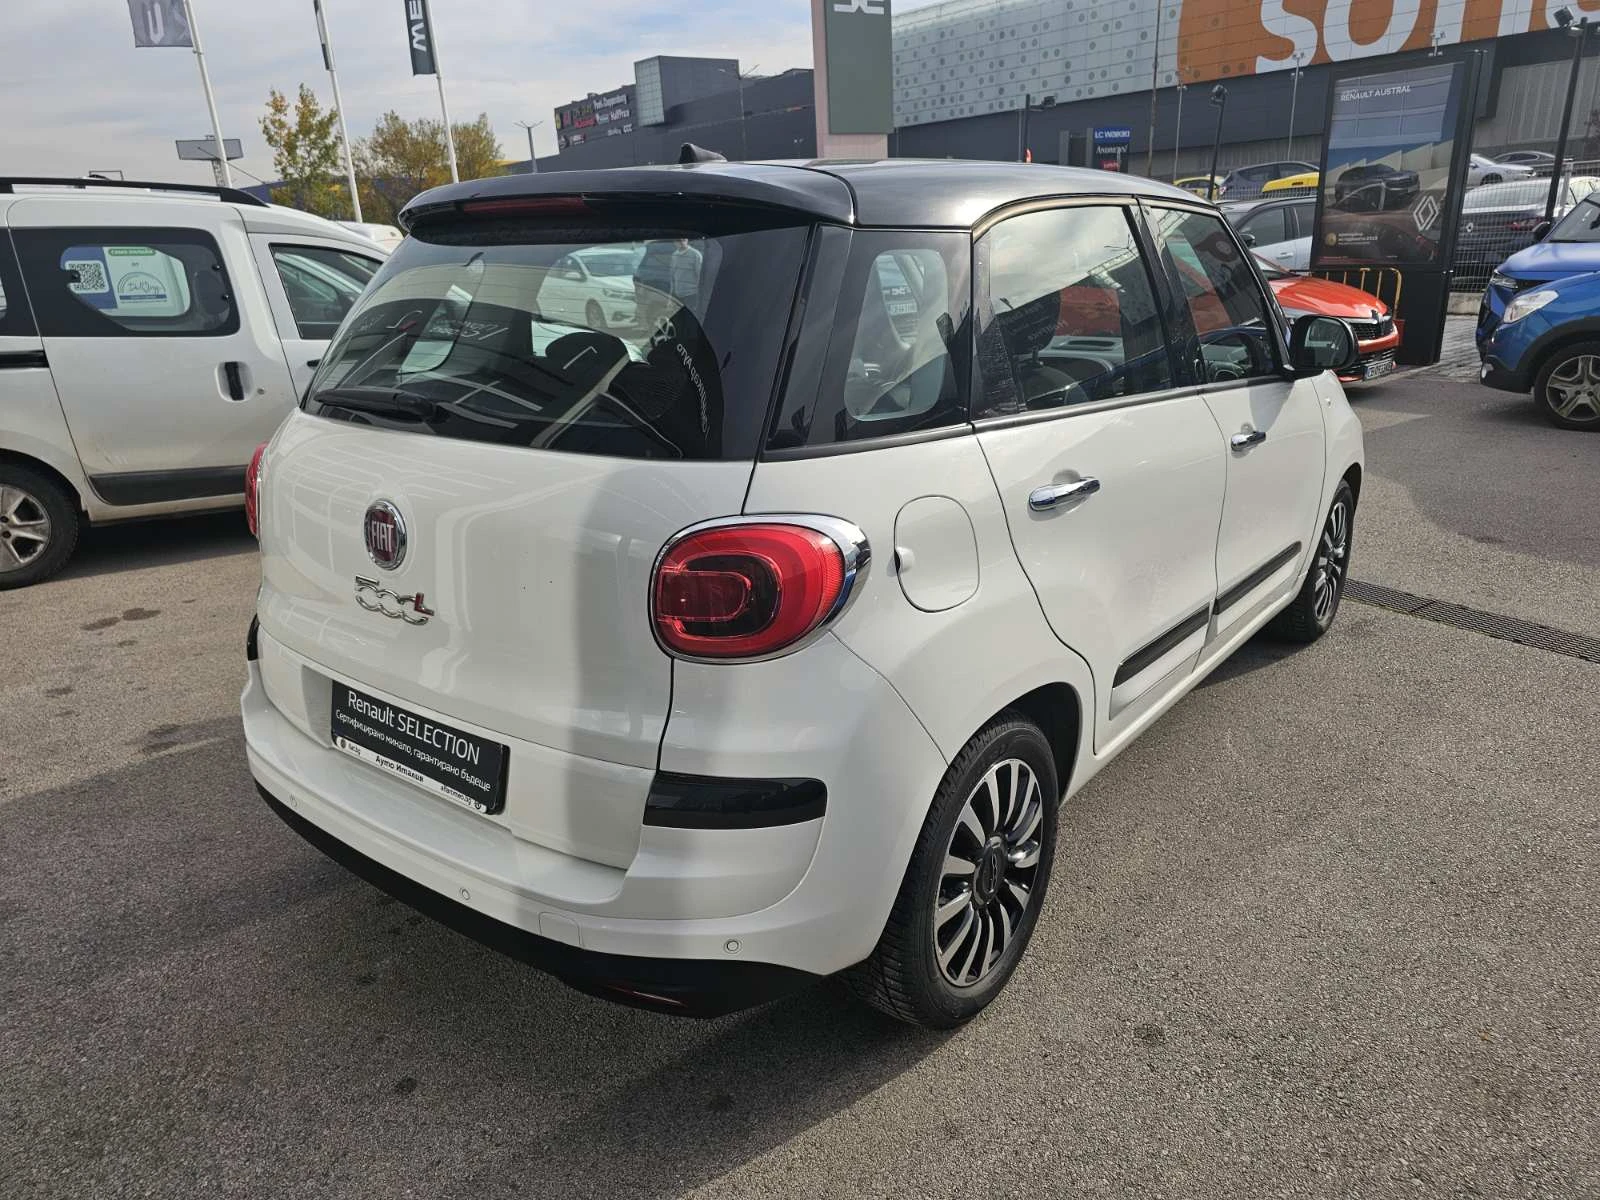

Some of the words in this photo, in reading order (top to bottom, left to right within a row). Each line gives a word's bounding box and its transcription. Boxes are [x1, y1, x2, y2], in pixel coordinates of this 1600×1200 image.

[1340, 90, 1373, 102] RENAULT
[1374, 85, 1411, 97] AUSTRAL
[371, 520, 394, 552] FIAT
[355, 574, 435, 626] 500L
[348, 690, 395, 727] Renault
[397, 713, 480, 765] SELECTION
[335, 709, 385, 741] Сертифицирано
[385, 735, 413, 756] минало,
[413, 748, 459, 777] гарантирано
[460, 768, 491, 792] бъдеще
[375, 756, 394, 771] Ауто
[396, 762, 424, 783] Италия
